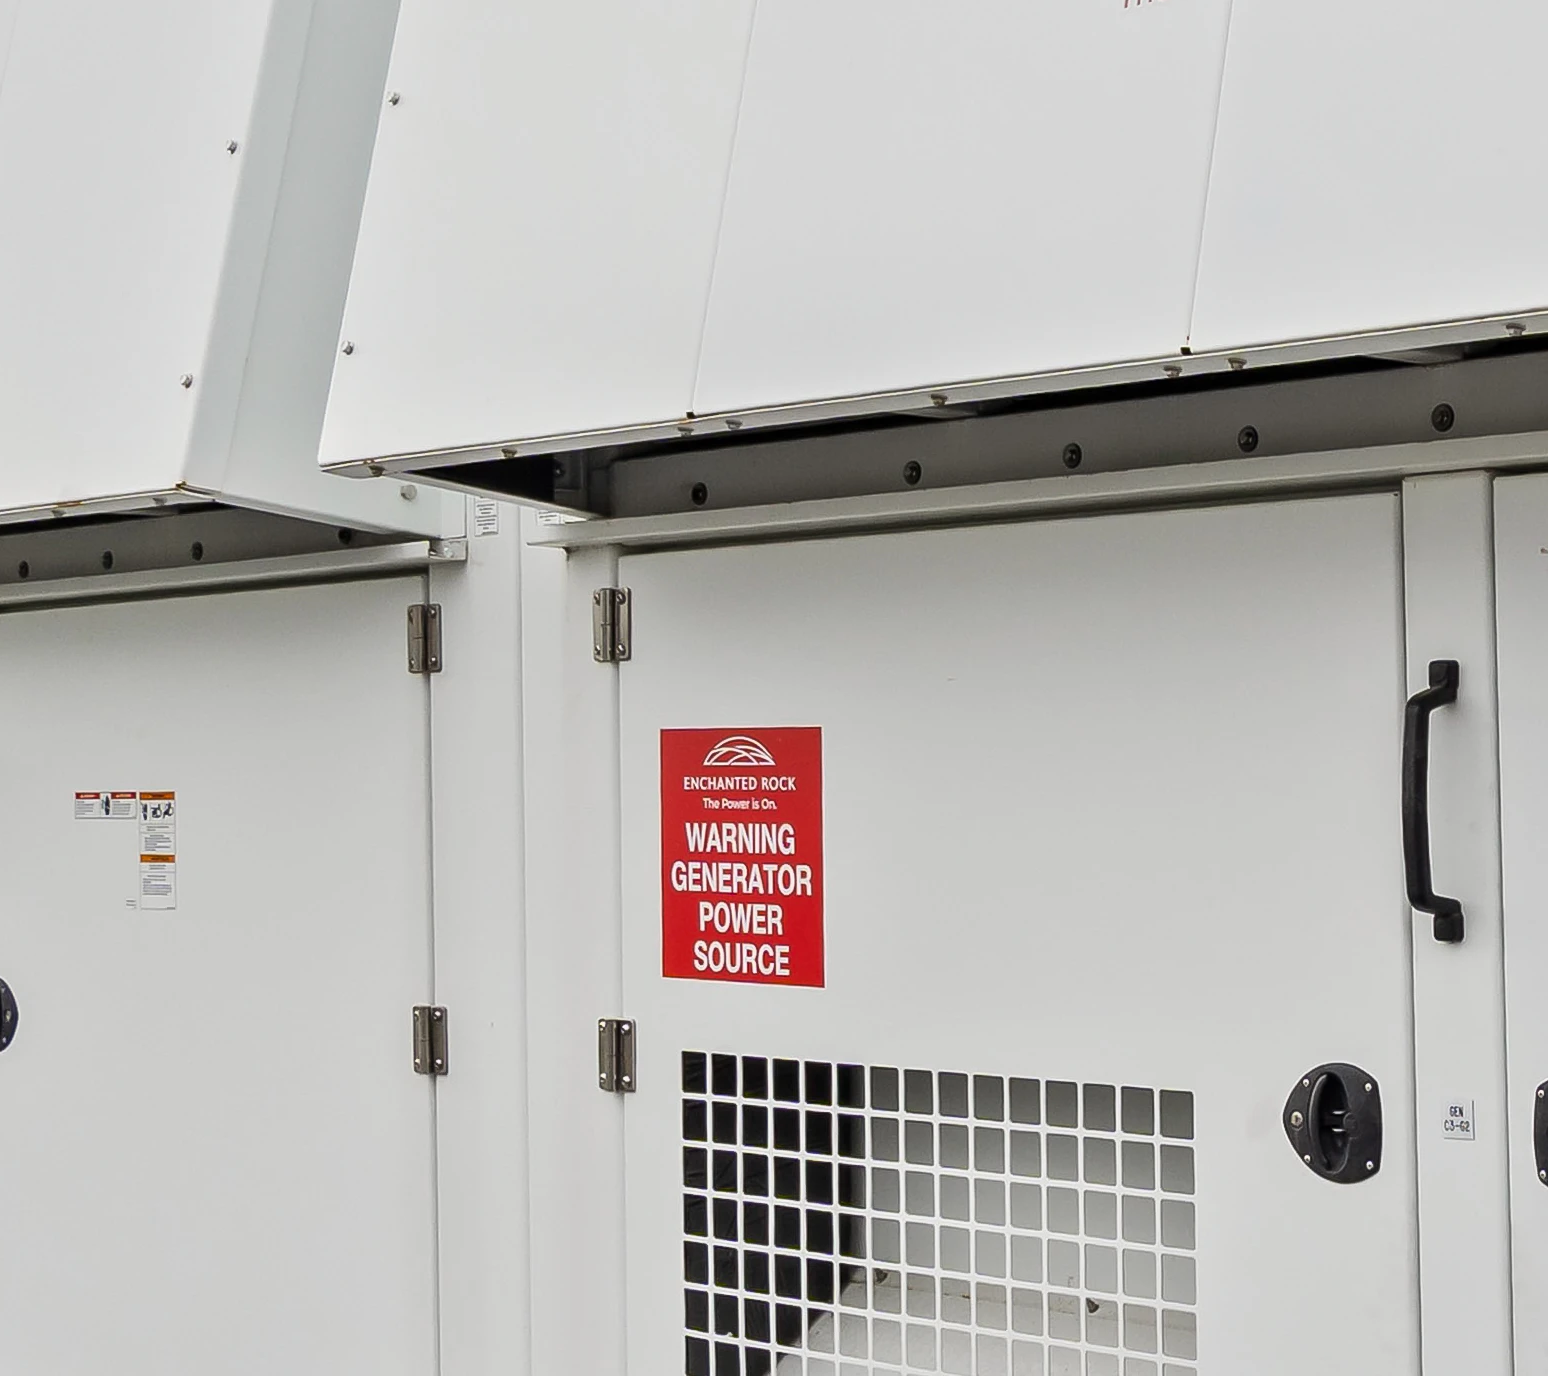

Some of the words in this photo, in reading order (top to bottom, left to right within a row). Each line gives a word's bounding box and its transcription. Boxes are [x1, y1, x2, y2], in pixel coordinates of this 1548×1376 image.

[683, 776, 758, 791] ENCHANTED
[761, 776, 796, 791] ROCK
[702, 797, 720, 810] The
[721, 797, 750, 810] Power
[752, 797, 760, 810] is
[685, 822, 795, 855] WARNING
[671, 860, 812, 896] GENERATOR
[699, 901, 783, 936] POWER
[693, 940, 790, 976] SOURCE
